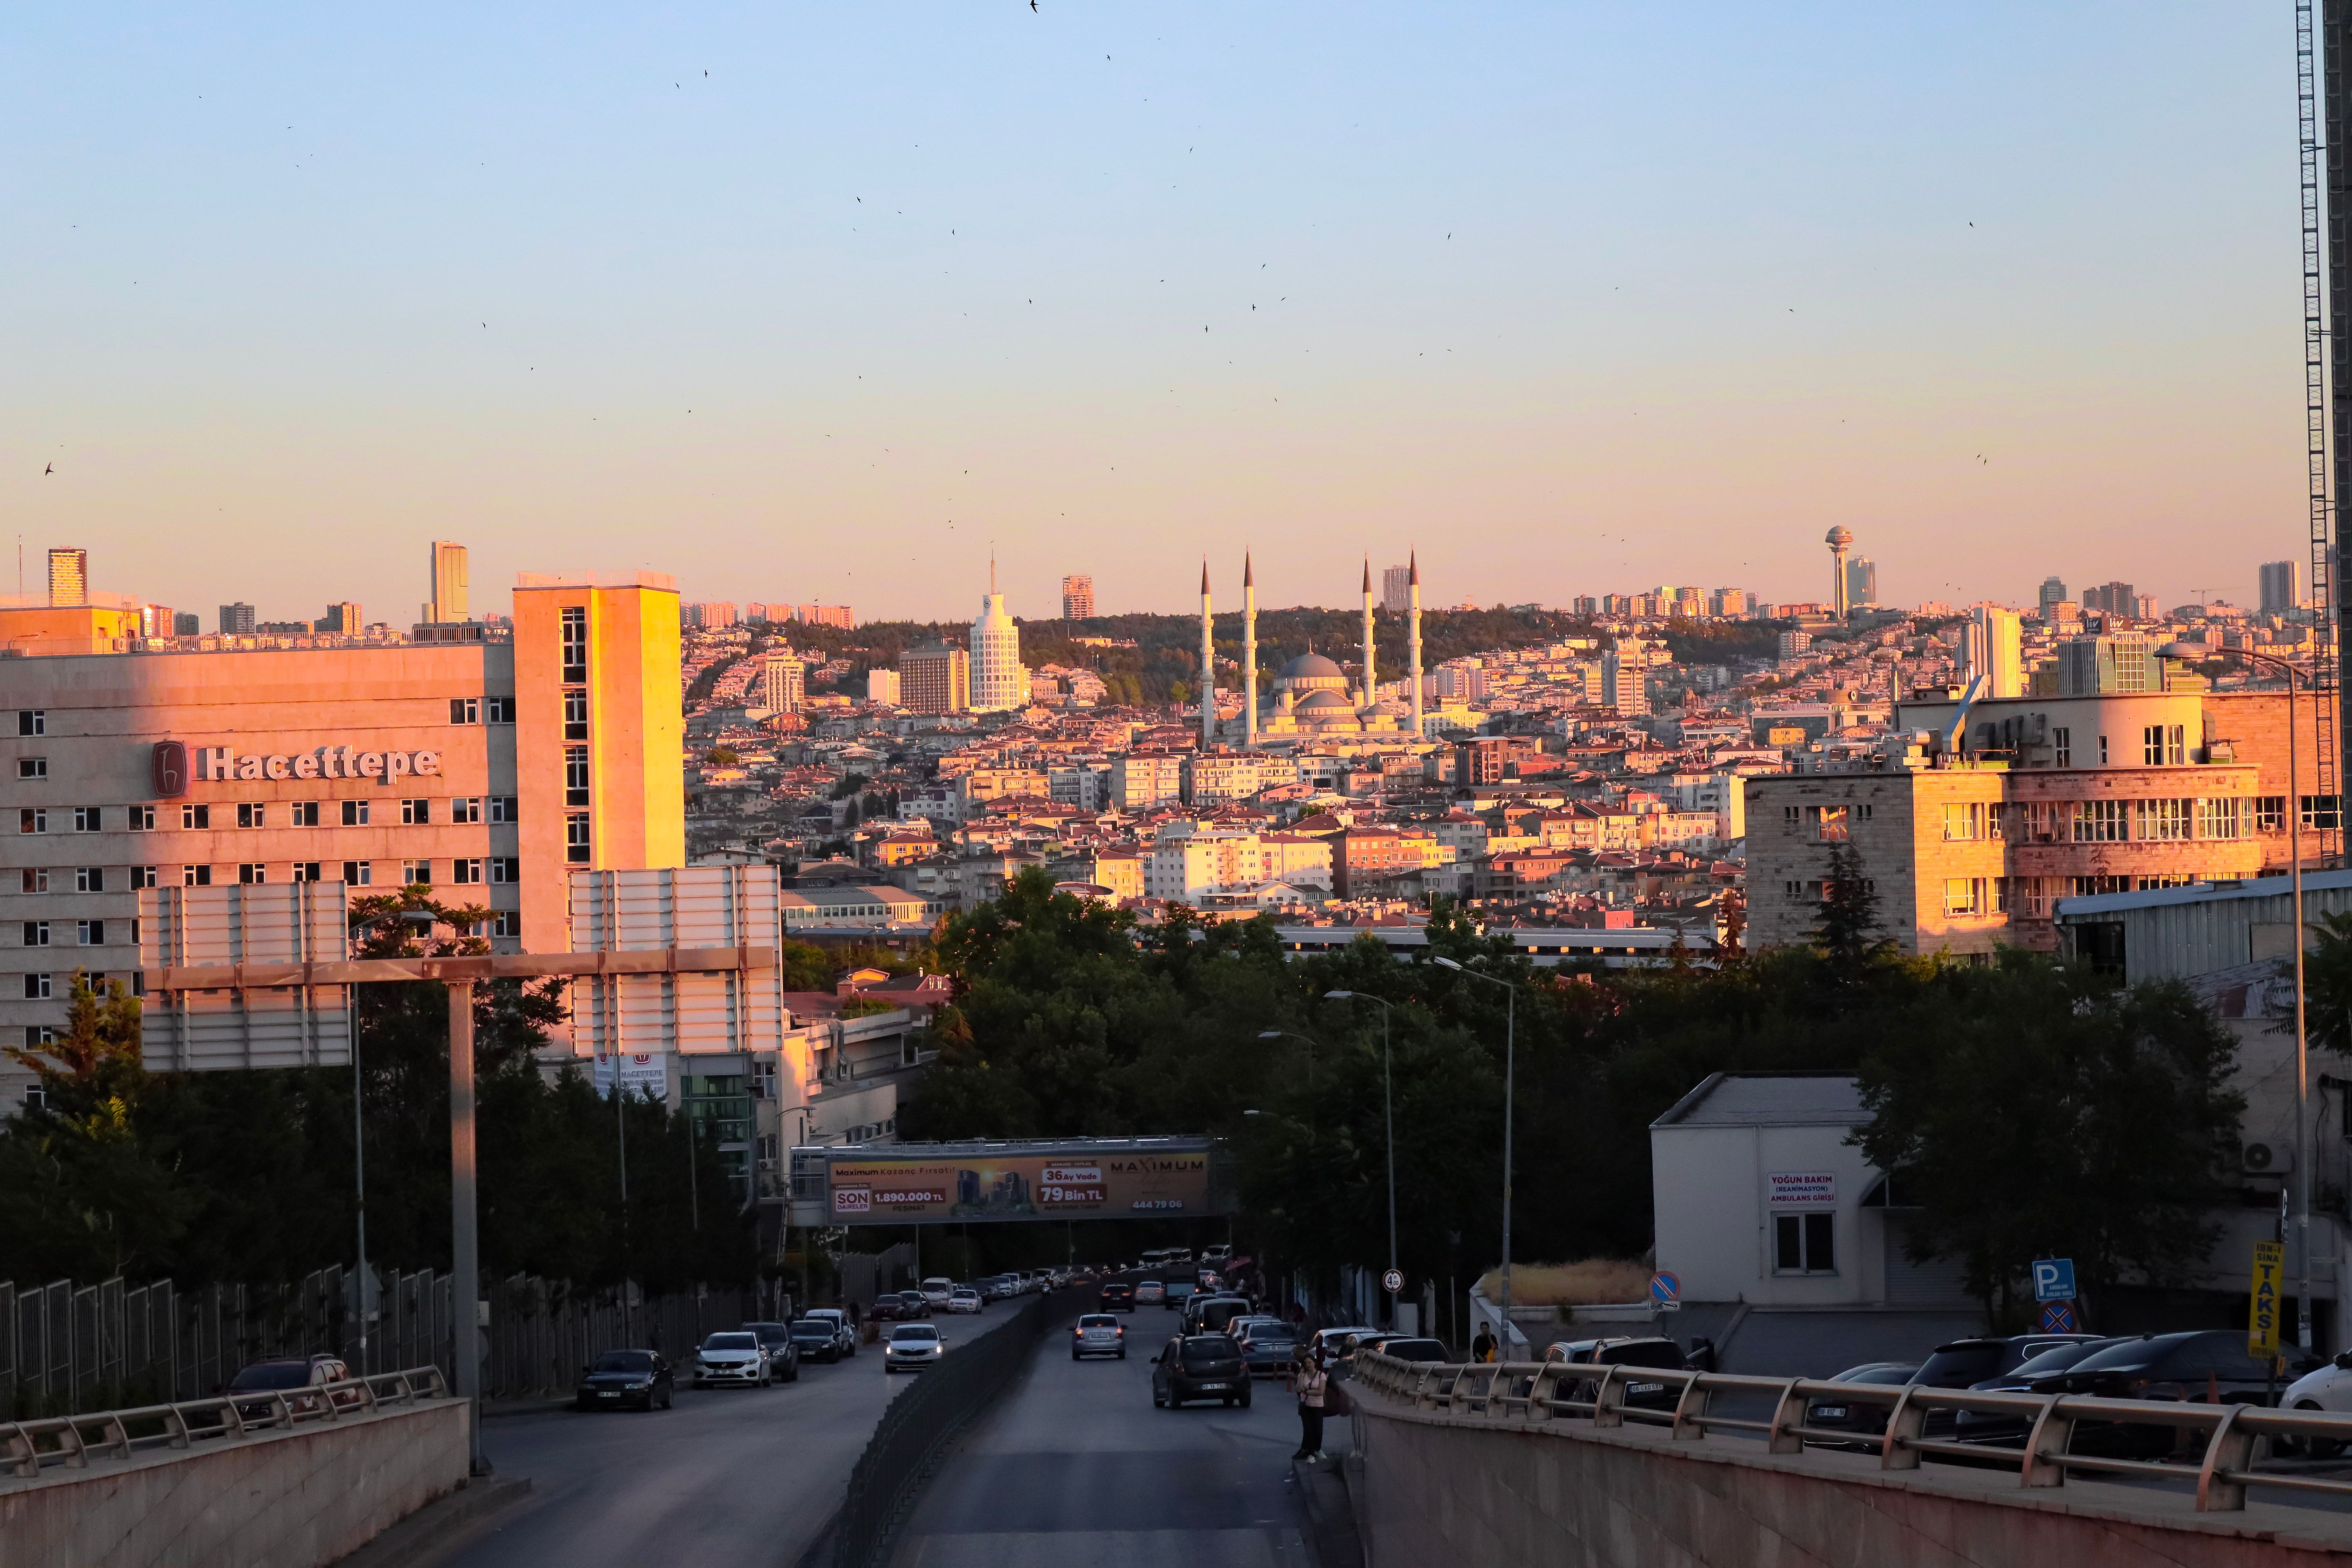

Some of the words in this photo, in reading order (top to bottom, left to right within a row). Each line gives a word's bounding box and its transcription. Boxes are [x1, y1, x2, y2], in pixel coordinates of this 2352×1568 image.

[205, 745, 439, 785] Hacettepe
[1111, 1157, 1203, 1173] MAXIMUM
[1046, 1171, 1063, 1181] 36
[1771, 1175, 1802, 1183] YOĞUN
[837, 1192, 868, 1204] SON
[875, 1192, 931, 1202] 1.890.000
[1040, 1187, 1063, 1201] 79
[1065, 1189, 1085, 1200] Bin
[1087, 1190, 1103, 1200] TL
[2036, 1265, 2058, 1296] P
